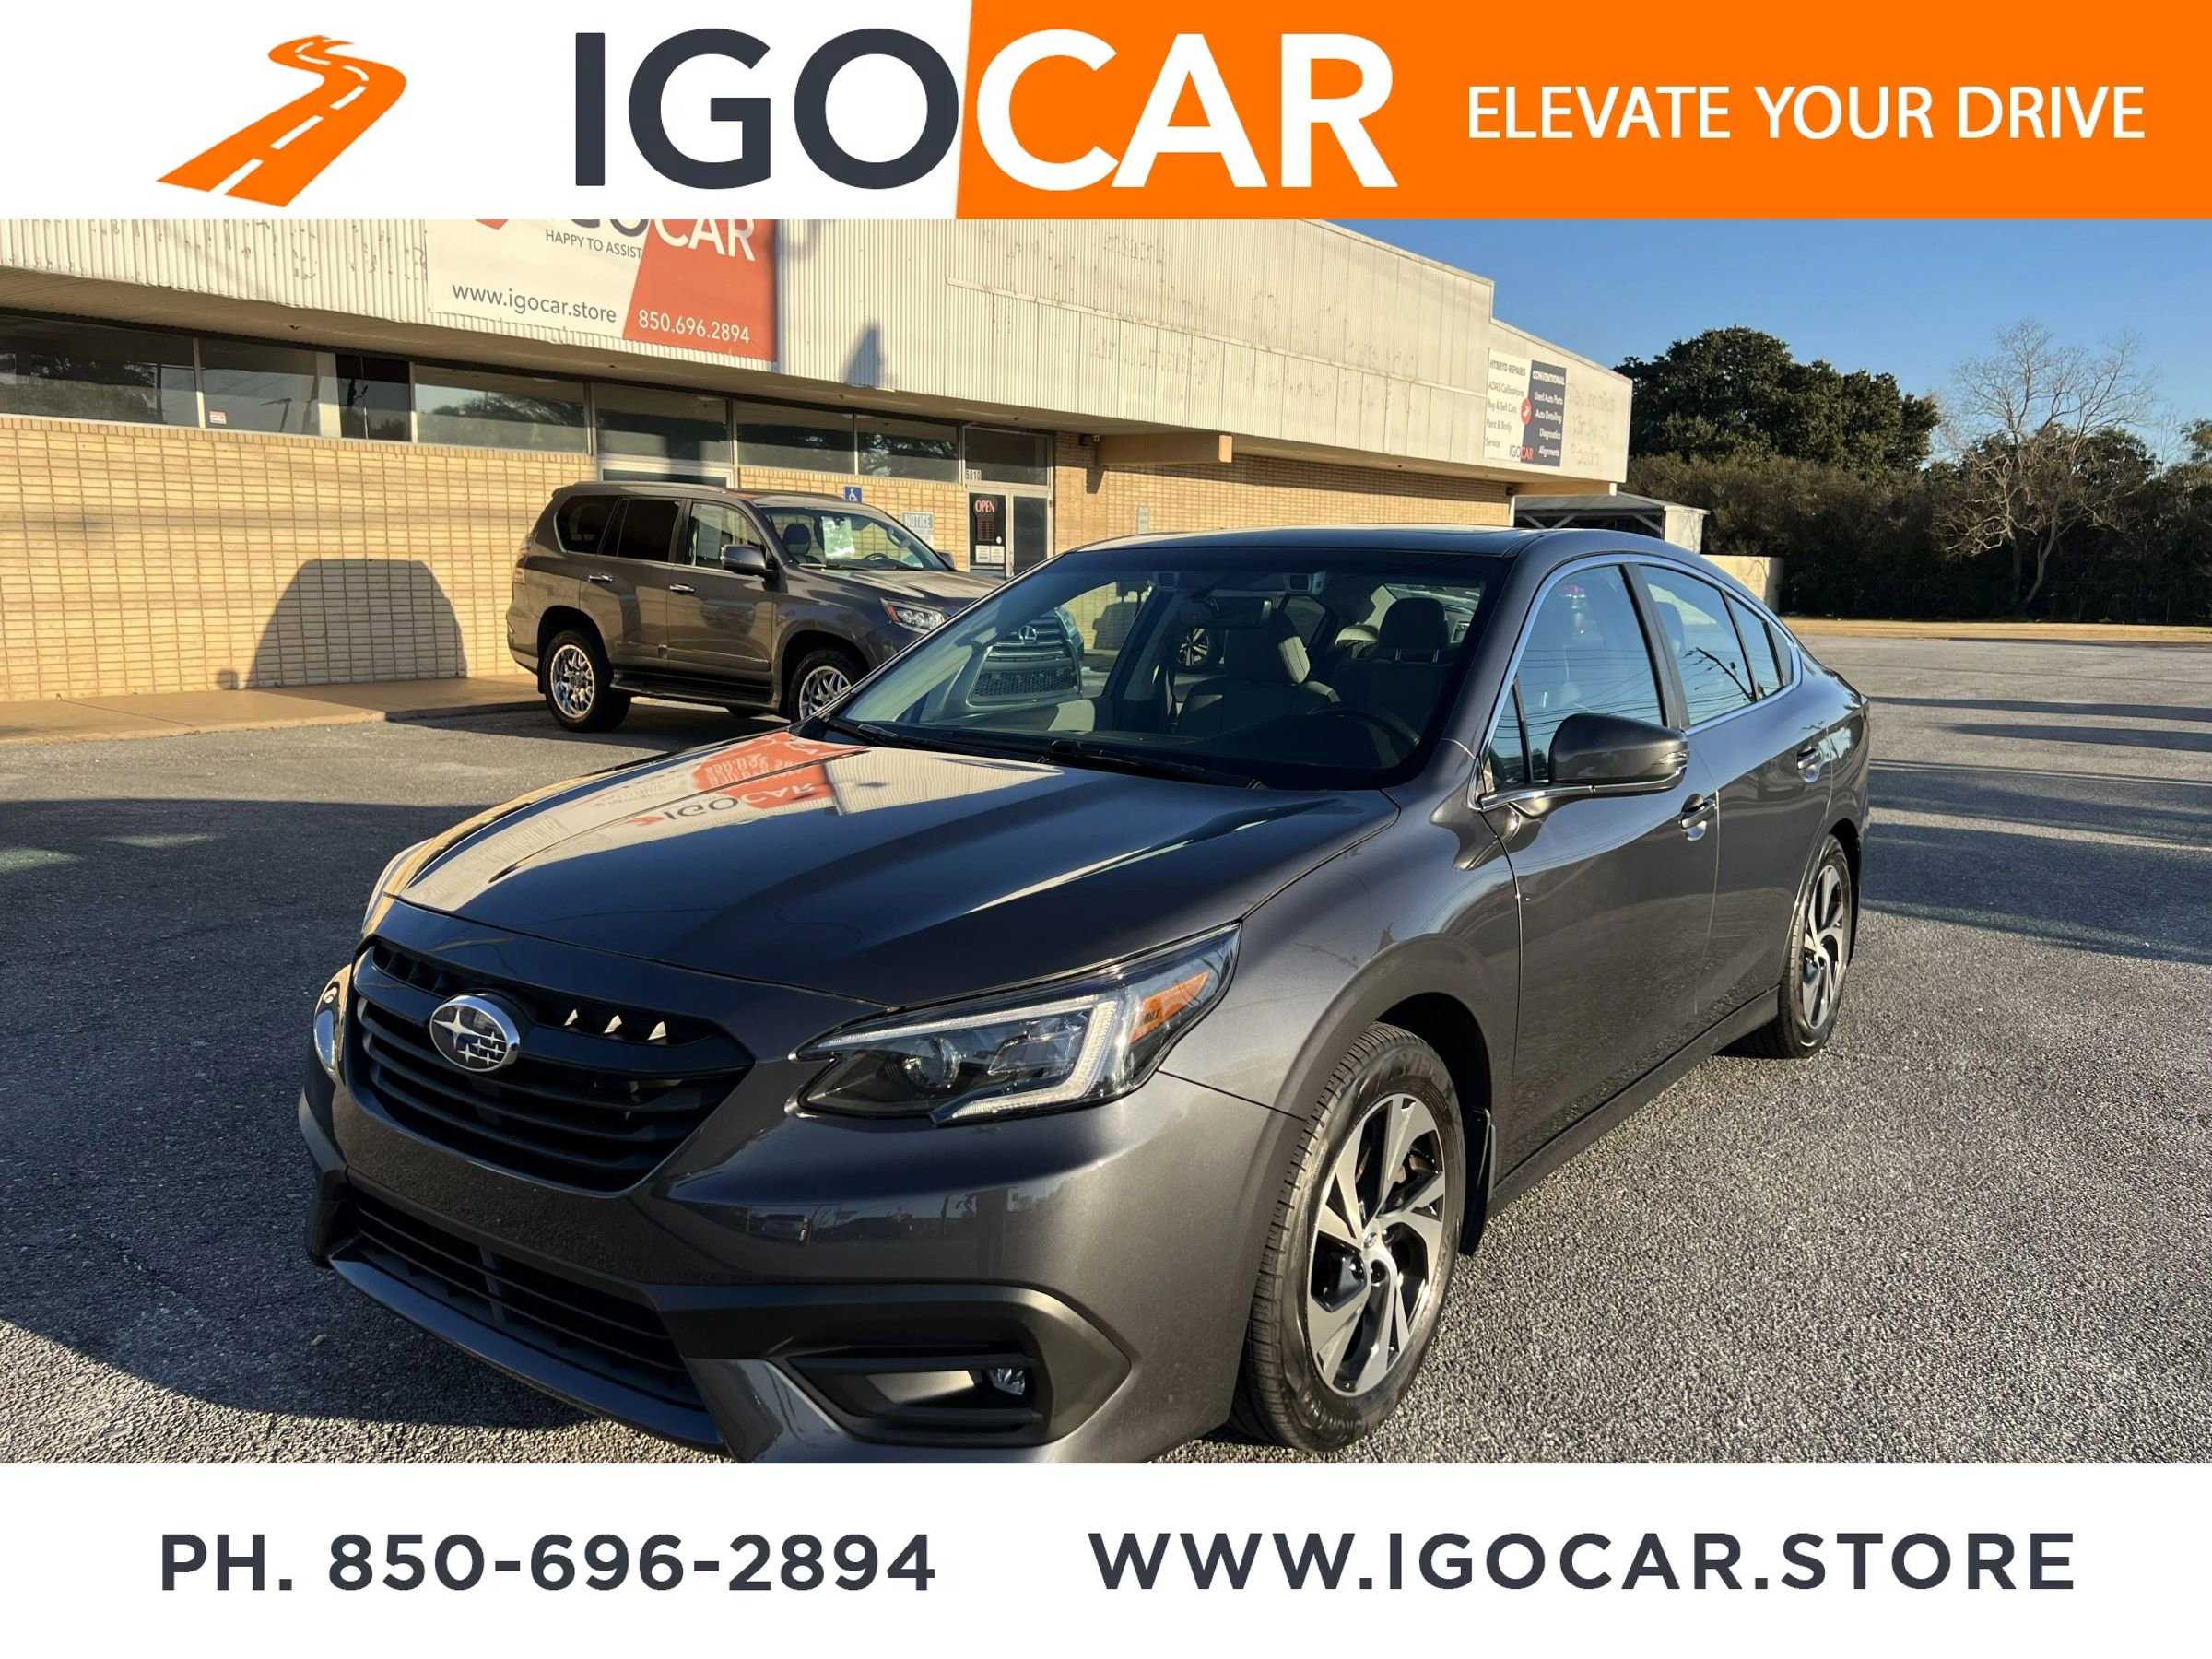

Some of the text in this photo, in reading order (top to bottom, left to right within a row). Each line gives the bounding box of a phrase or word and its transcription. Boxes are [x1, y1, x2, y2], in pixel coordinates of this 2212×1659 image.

[546, 229, 642, 259] HAPPY TO ASSIST
[452, 284, 618, 324] www.igocar.store
[639, 310, 750, 344] 850.696.2894
[1509, 364, 1526, 377] REPAIRS
[1509, 444, 1534, 460] IGOCAR
[975, 500, 995, 513] OPEN
[904, 513, 930, 528] NOTICE
